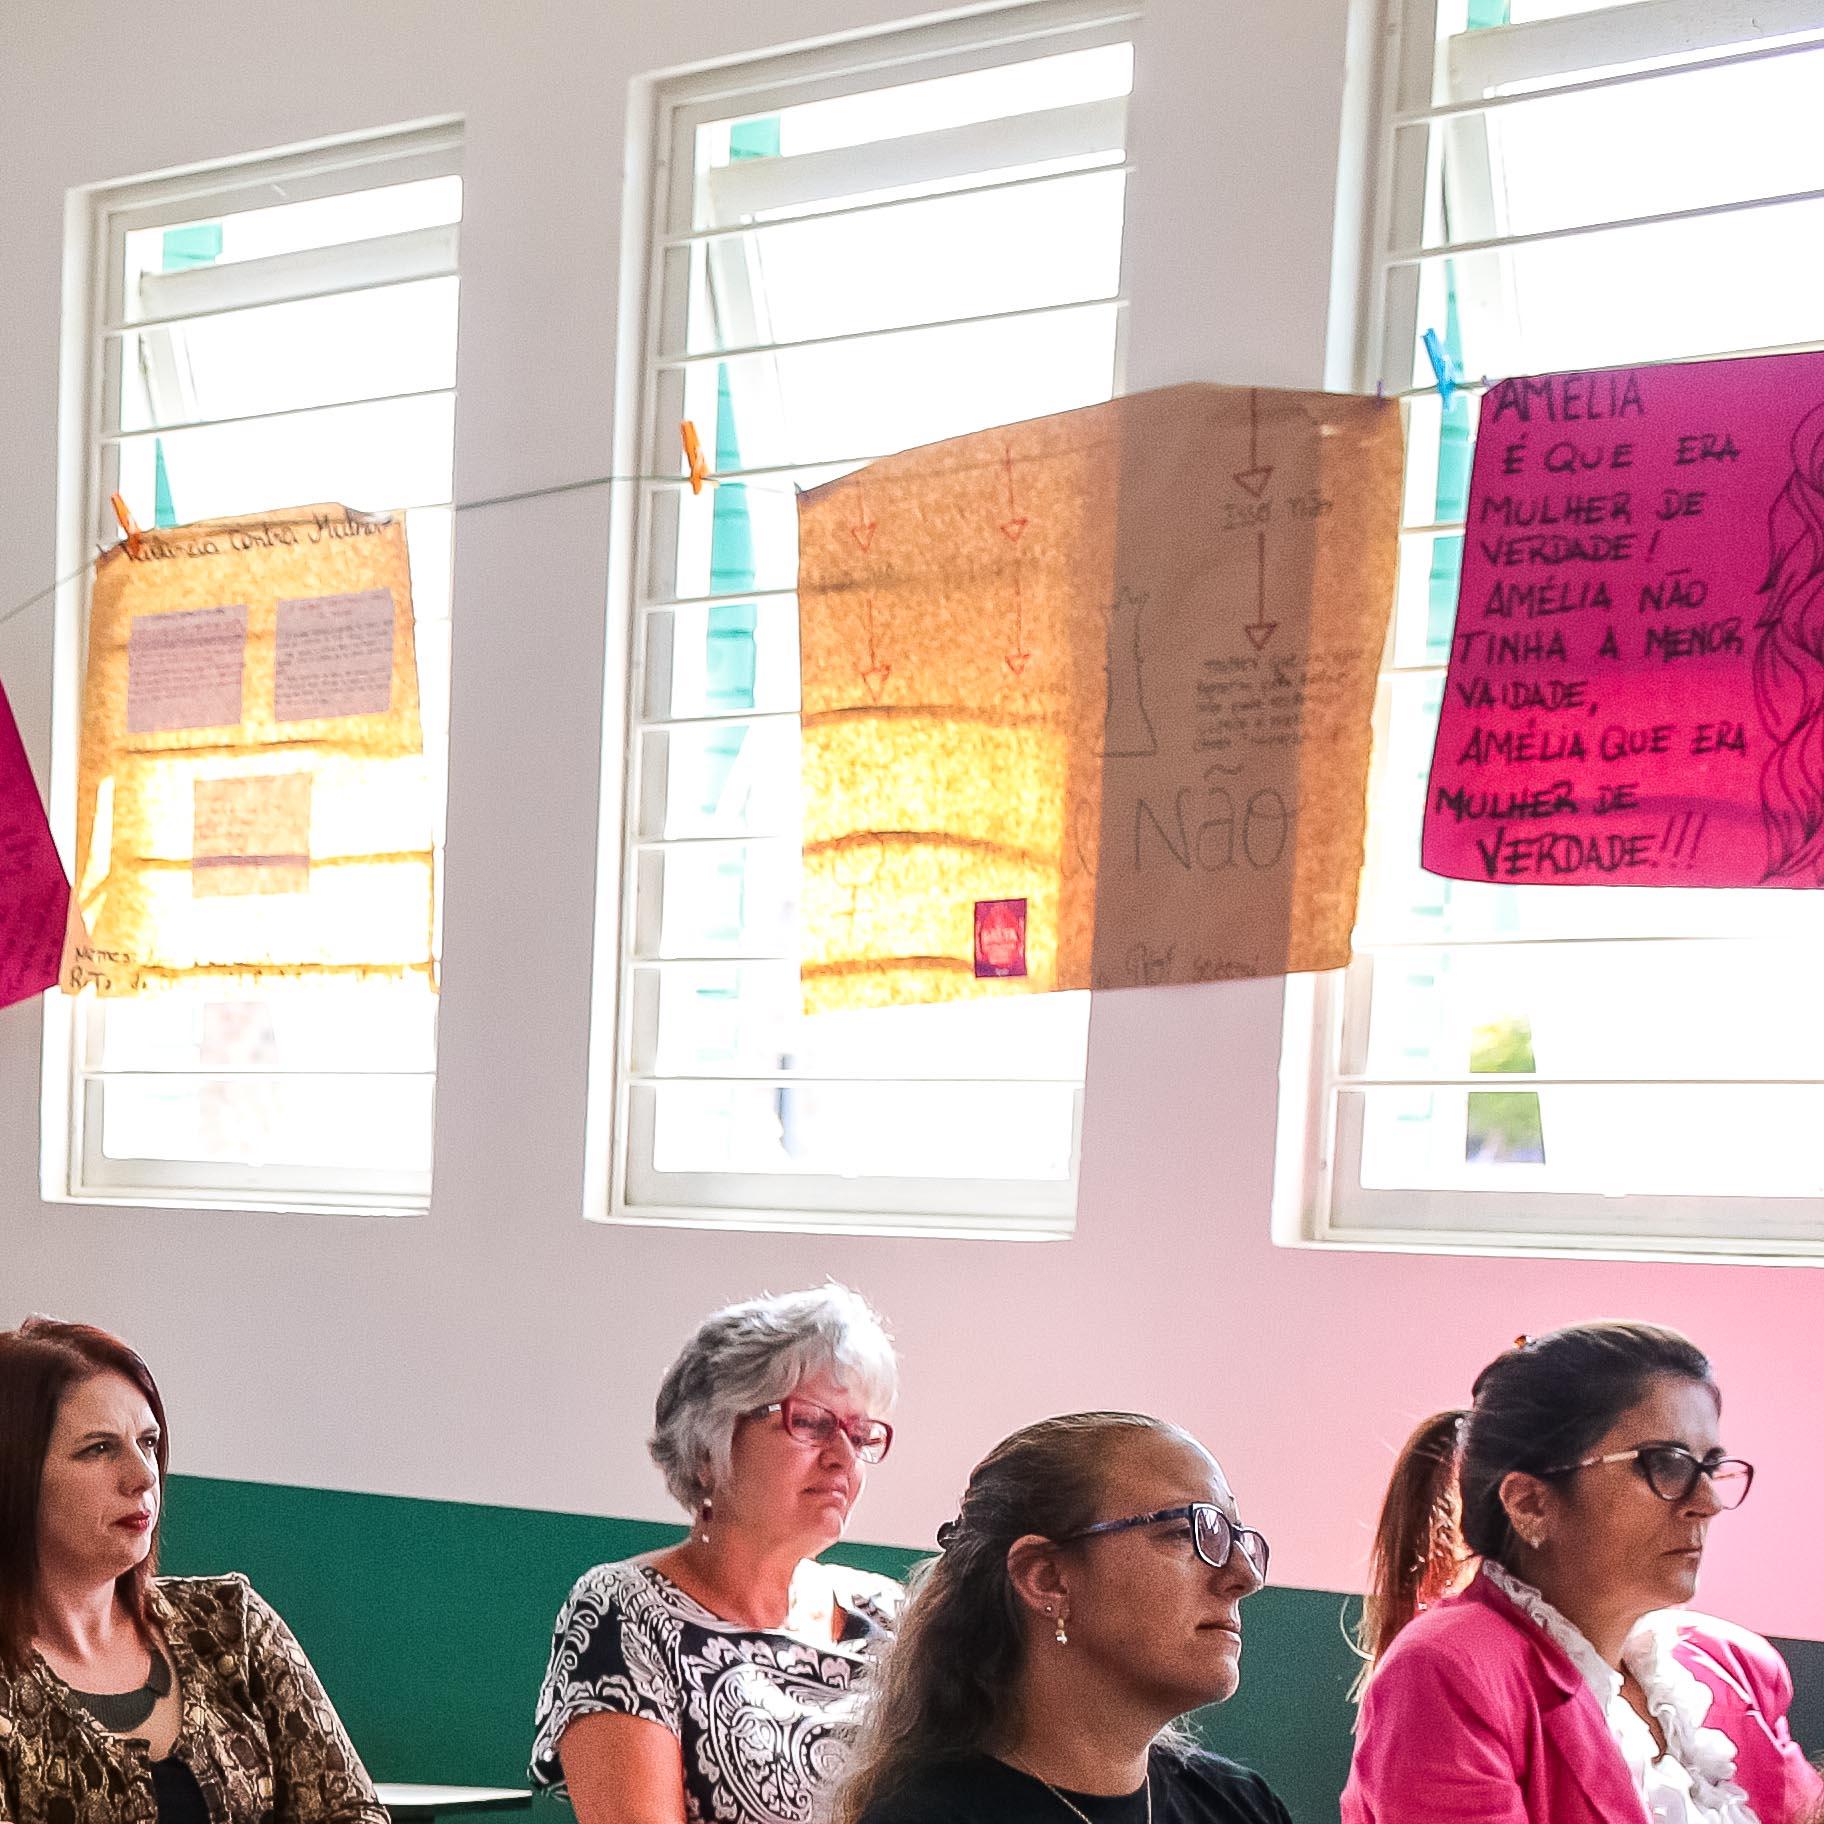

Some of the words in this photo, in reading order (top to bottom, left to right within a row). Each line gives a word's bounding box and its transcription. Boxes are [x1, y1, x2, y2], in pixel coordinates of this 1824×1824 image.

[1502, 432, 1525, 475] É
[1544, 441, 1634, 475] QUE
[1675, 433, 1740, 467] ERA
[1481, 494, 1633, 528] MULHER
[1658, 489, 1707, 521] DE
[1484, 574, 1612, 618] AMÉLIA
[1639, 568, 1708, 613] NÃO
[1458, 630, 1566, 666] TINHA
[1599, 626, 1620, 659] A
[1647, 616, 1744, 663] MENOR
[1457, 678, 1599, 717] VAIDADE,
[1600, 722, 1677, 761] QUE
[1692, 721, 1747, 757] ERA
[1135, 762, 1299, 873] Não
[1435, 781, 1575, 825] MULHER
[1594, 782, 1640, 816] DE
